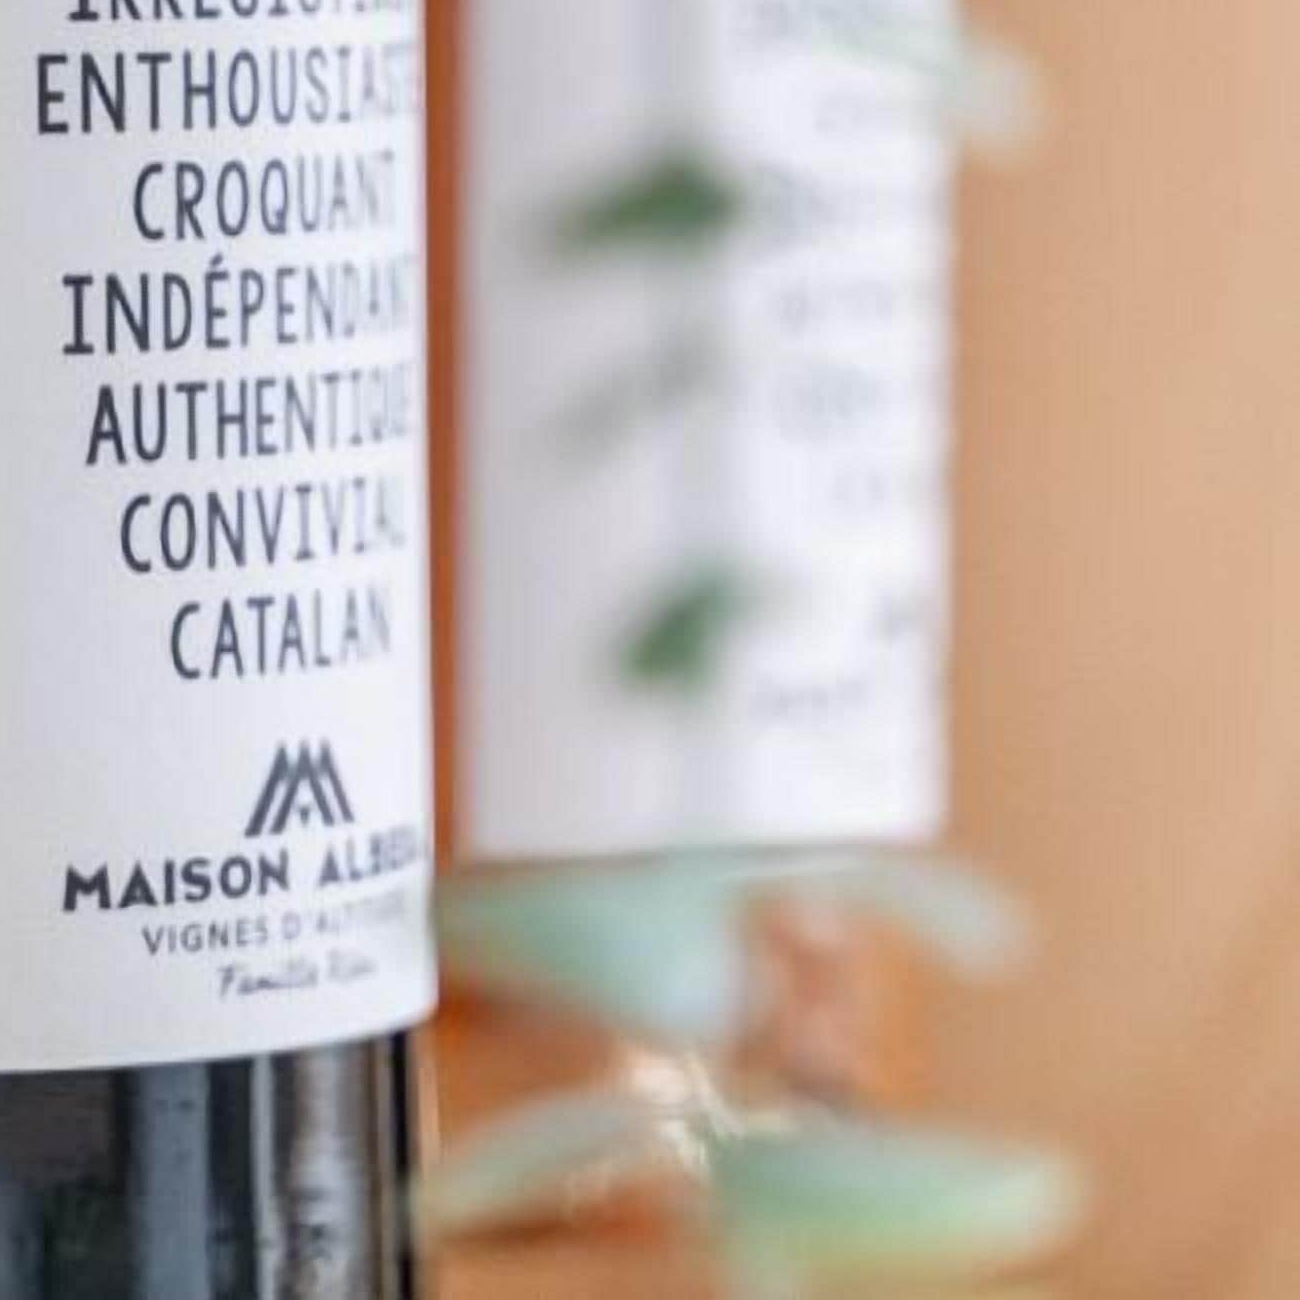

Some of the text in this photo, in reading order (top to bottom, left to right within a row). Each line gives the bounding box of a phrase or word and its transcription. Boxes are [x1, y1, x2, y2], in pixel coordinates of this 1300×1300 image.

[170, 584, 392, 681] CATALAN
[62, 846, 291, 913] MAISON
[140, 912, 270, 959] VIGNES
